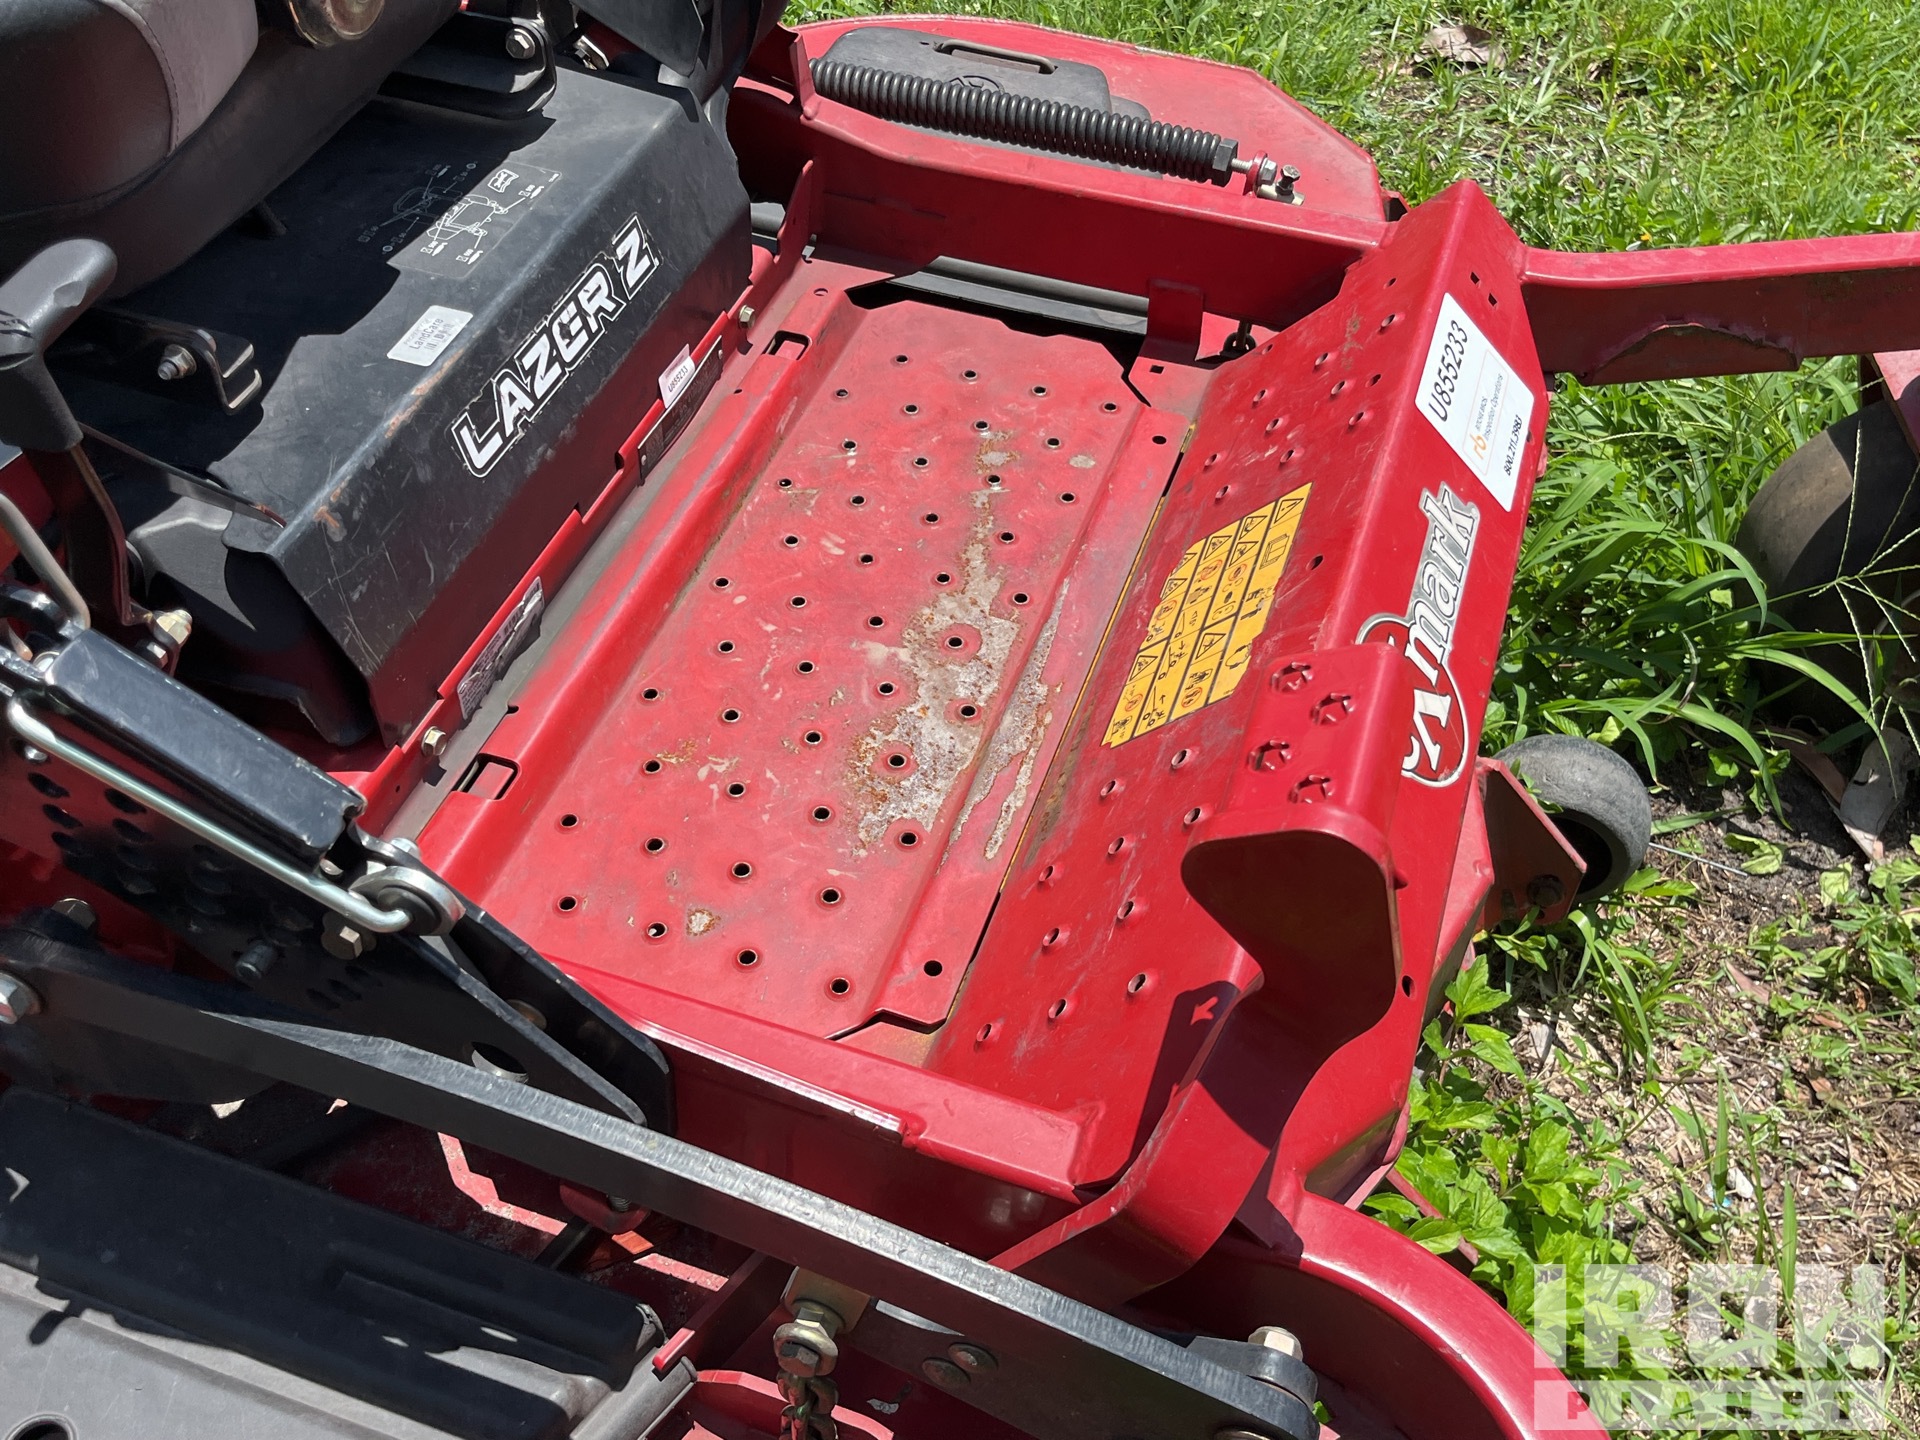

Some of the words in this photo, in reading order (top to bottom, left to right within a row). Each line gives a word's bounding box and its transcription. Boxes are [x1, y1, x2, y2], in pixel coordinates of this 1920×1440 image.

[409, 318, 444, 350] LandCare
[457, 268, 620, 471] LAZER
[613, 220, 656, 295] Z
[1427, 319, 1468, 423] U855233
[1503, 413, 1523, 477] 800.211.3983
